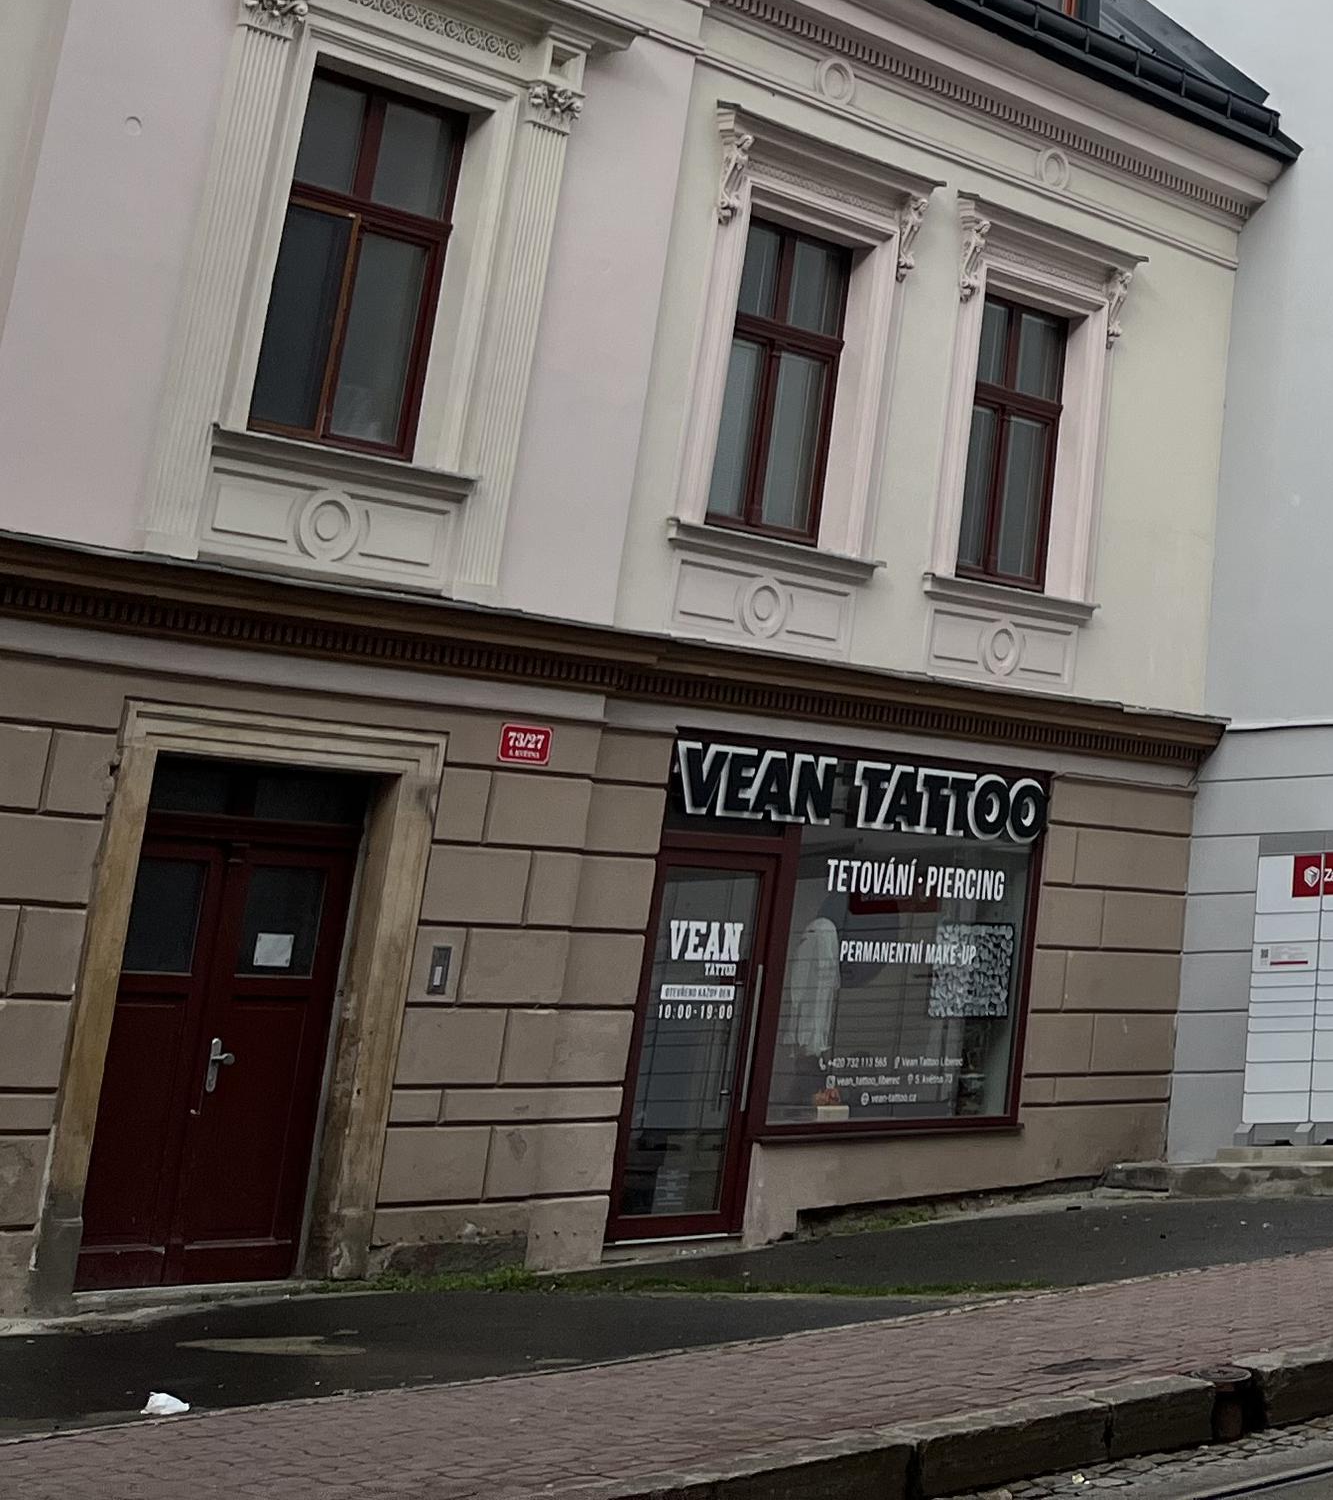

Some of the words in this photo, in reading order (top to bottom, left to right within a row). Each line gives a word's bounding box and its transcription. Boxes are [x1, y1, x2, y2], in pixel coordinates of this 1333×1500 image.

[508, 731, 545, 750] 73/27
[675, 740, 837, 825] VEAN
[855, 759, 1046, 843] TATTOO
[827, 857, 917, 897] TETOVÁNÍ
[925, 866, 1005, 901] PIERCING
[670, 920, 744, 962] VEAN
[839, 940, 924, 964] PERMANENTNÍ
[924, 944, 977, 965] MAKE-UP
